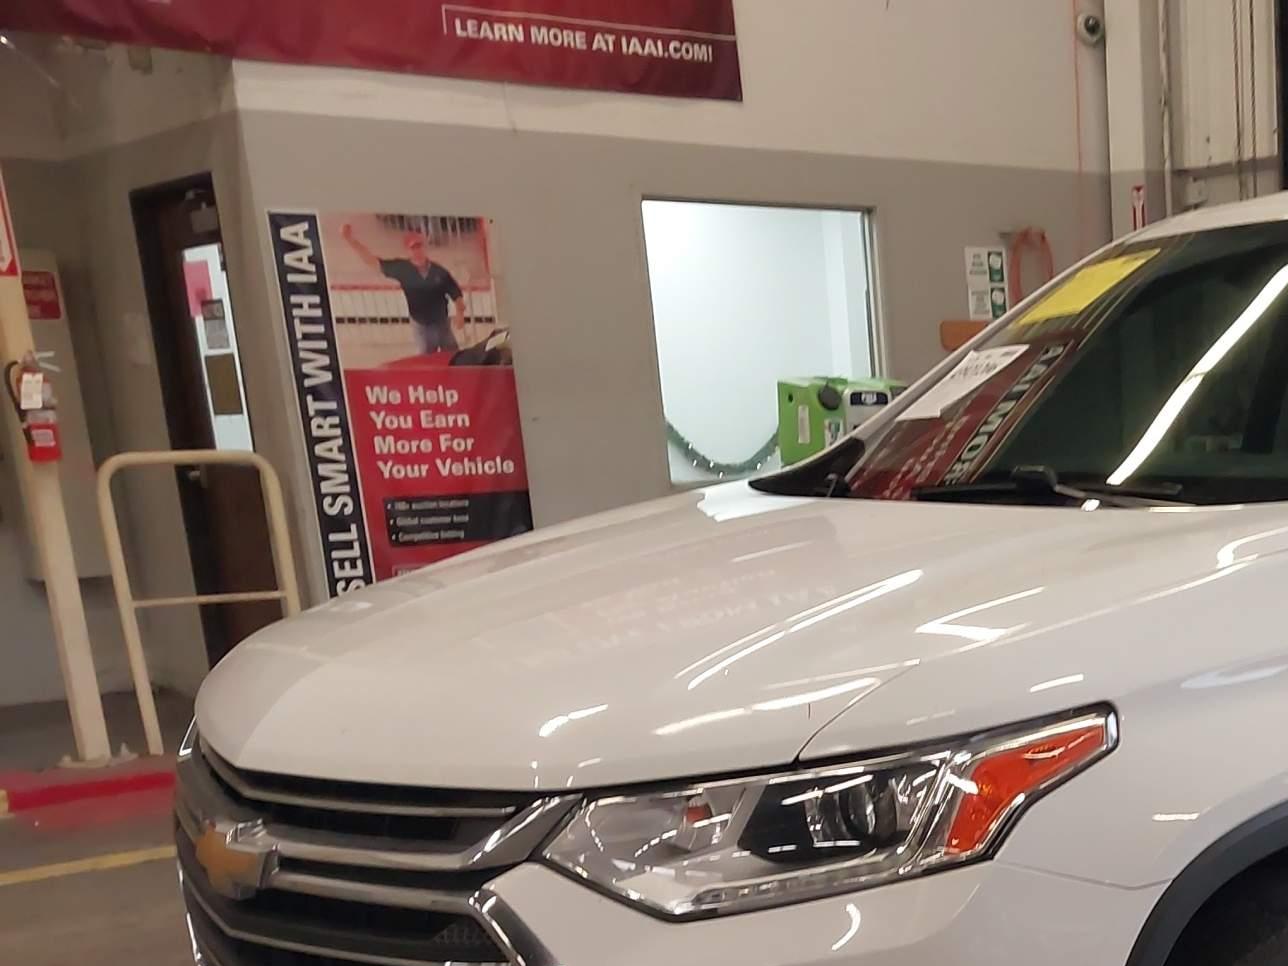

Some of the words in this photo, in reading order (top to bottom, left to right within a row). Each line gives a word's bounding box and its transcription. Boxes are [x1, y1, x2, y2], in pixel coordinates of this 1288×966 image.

[454, 17, 524, 43] LEARN
[530, 26, 587, 49] MORE
[592, 34, 616, 53] AT
[279, 221, 318, 284] IAA
[289, 295, 333, 388] WITH
[365, 385, 401, 405] We
[408, 384, 459, 407] Help
[369, 410, 413, 430] You
[419, 409, 470, 429] Earn
[307, 394, 354, 516] SMART
[373, 434, 433, 454] More
[439, 434, 475, 453] For
[376, 459, 429, 479] Your
[435, 455, 515, 477] Vehicle
[328, 522, 367, 597] SELL
